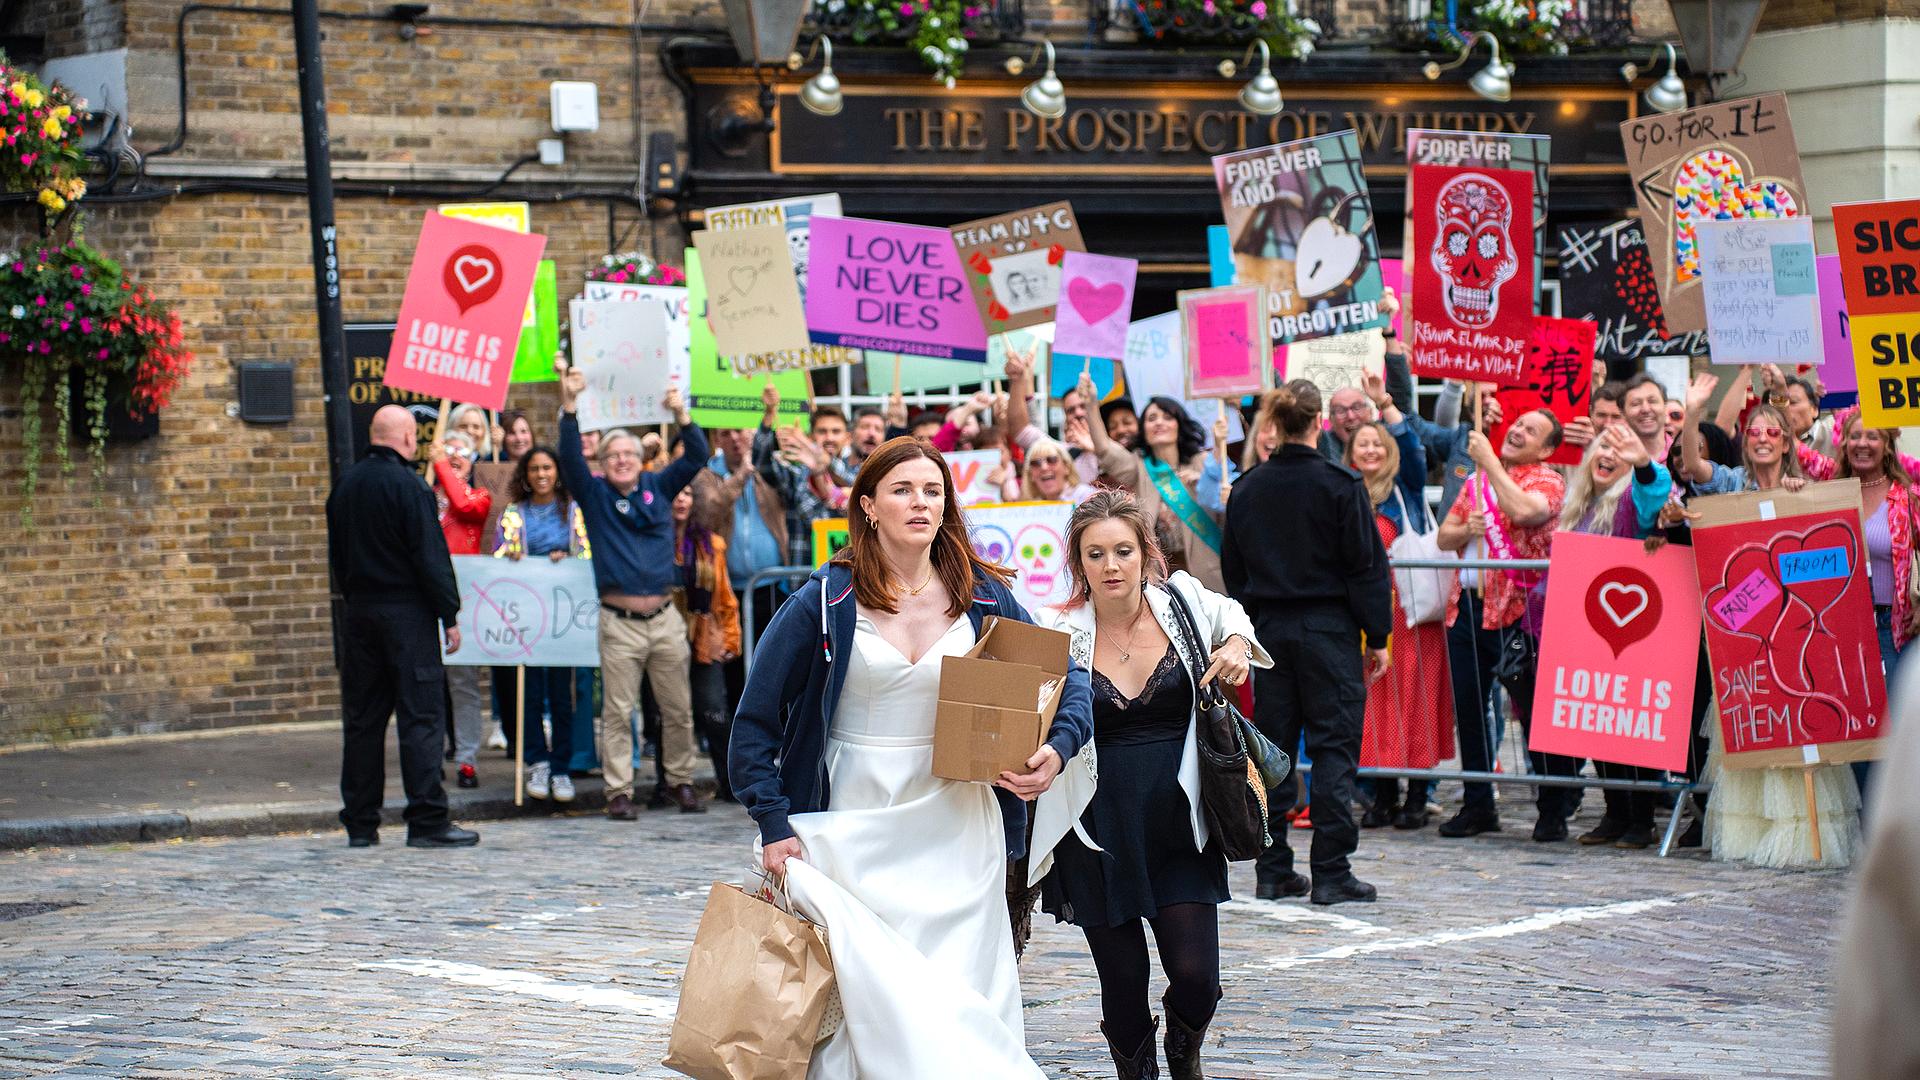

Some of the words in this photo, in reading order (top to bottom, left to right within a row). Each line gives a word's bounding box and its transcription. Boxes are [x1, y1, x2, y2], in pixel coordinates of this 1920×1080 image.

[884, 107, 987, 151] THE
[1006, 107, 1257, 153] PROSPECT
[1225, 148, 1322, 184] FOREVER
[1417, 138, 1511, 161] FOREVER
[1231, 182, 1276, 208] AND
[846, 235, 943, 269] LOVE
[953, 222, 1009, 248] TEAM
[1560, 218, 1646, 273] #Tea
[837, 265, 964, 302] NEVER
[1269, 290, 1293, 313] OT
[856, 298, 939, 330] DIES
[1270, 300, 1379, 339] ORGOTTEN
[408, 318, 470, 353] LOVE
[476, 334, 502, 361] IS
[1458, 330, 1472, 347] EL
[1474, 332, 1503, 352] AMOR
[1503, 336, 1525, 354] DE
[403, 345, 492, 387] ETERNAL
[348, 381, 382, 404] OF
[1784, 553, 1839, 577] GROOM
[485, 627, 530, 646] NOT
[1554, 666, 1628, 705] LOVE
[1641, 678, 1672, 710] IS
[1719, 659, 1770, 704] SAVE
[1552, 697, 1667, 742] ETERNAL
[1722, 703, 1793, 751] THEM
